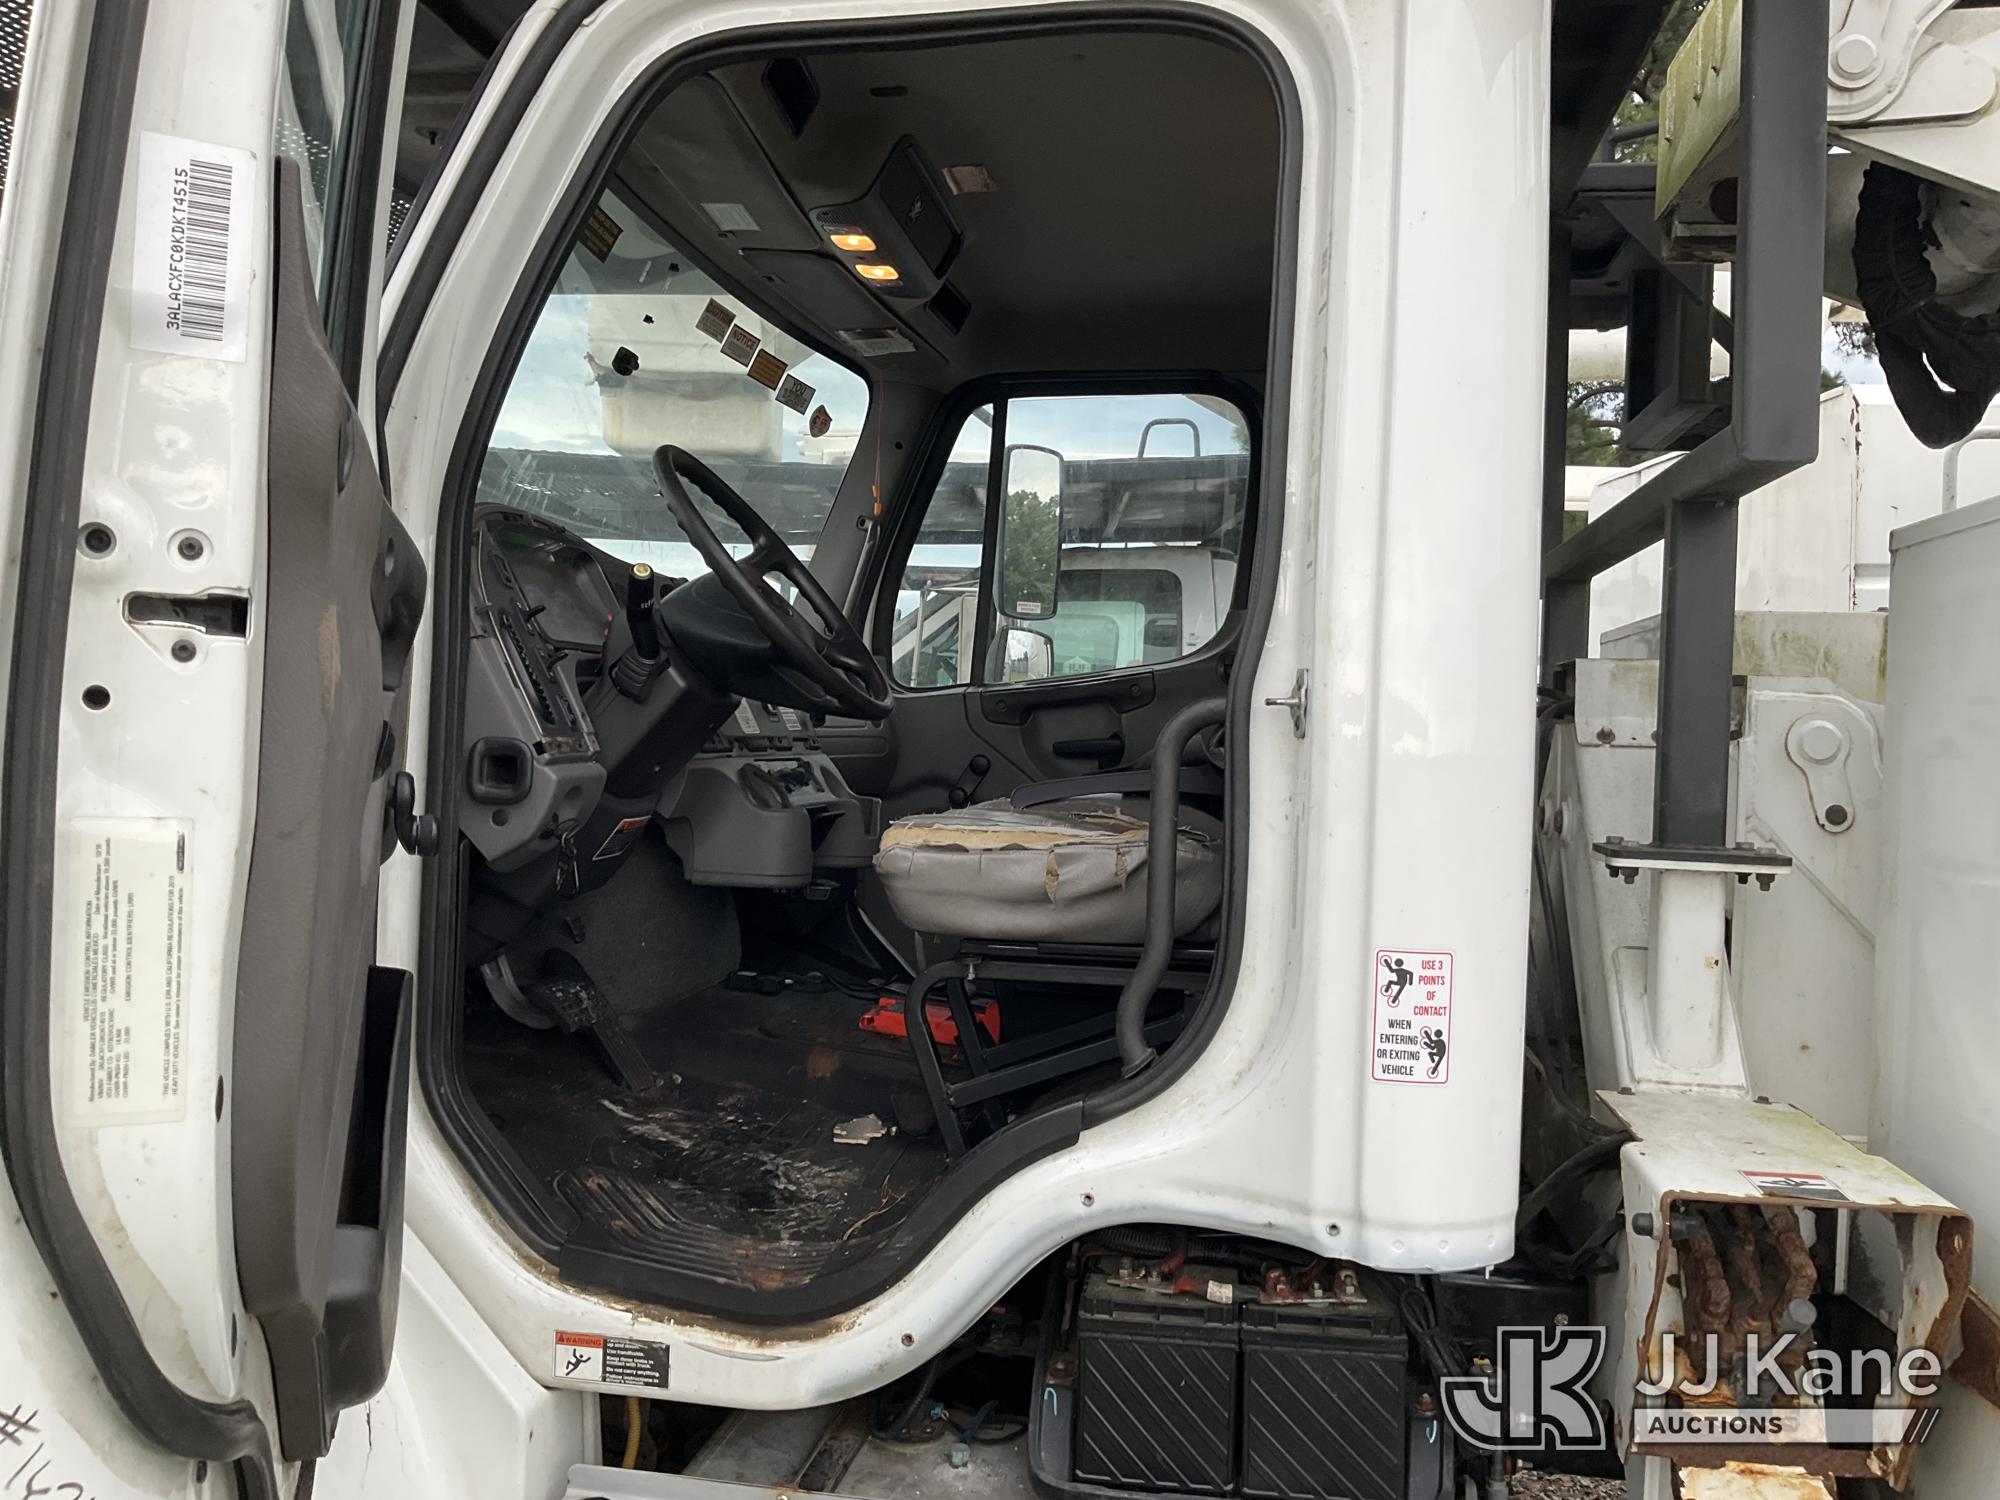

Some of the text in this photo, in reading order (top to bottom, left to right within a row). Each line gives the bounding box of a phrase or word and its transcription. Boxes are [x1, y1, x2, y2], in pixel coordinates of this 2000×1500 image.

[167, 167, 189, 330] 3ALACXFC0KDKT4515
[1421, 960, 1444, 970] USE 3
[1418, 975, 1445, 986] POINTS
[1426, 991, 1437, 1001] OF
[1413, 1006, 1447, 1017] CONTACT
[1388, 1018, 1412, 1030] WHEN
[1380, 1033, 1419, 1046] ENTERING
[1376, 1048, 1421, 1061] OR EXITING
[1381, 1063, 1415, 1076] VEHICLE
[565, 1336, 602, 1347] WARNING
